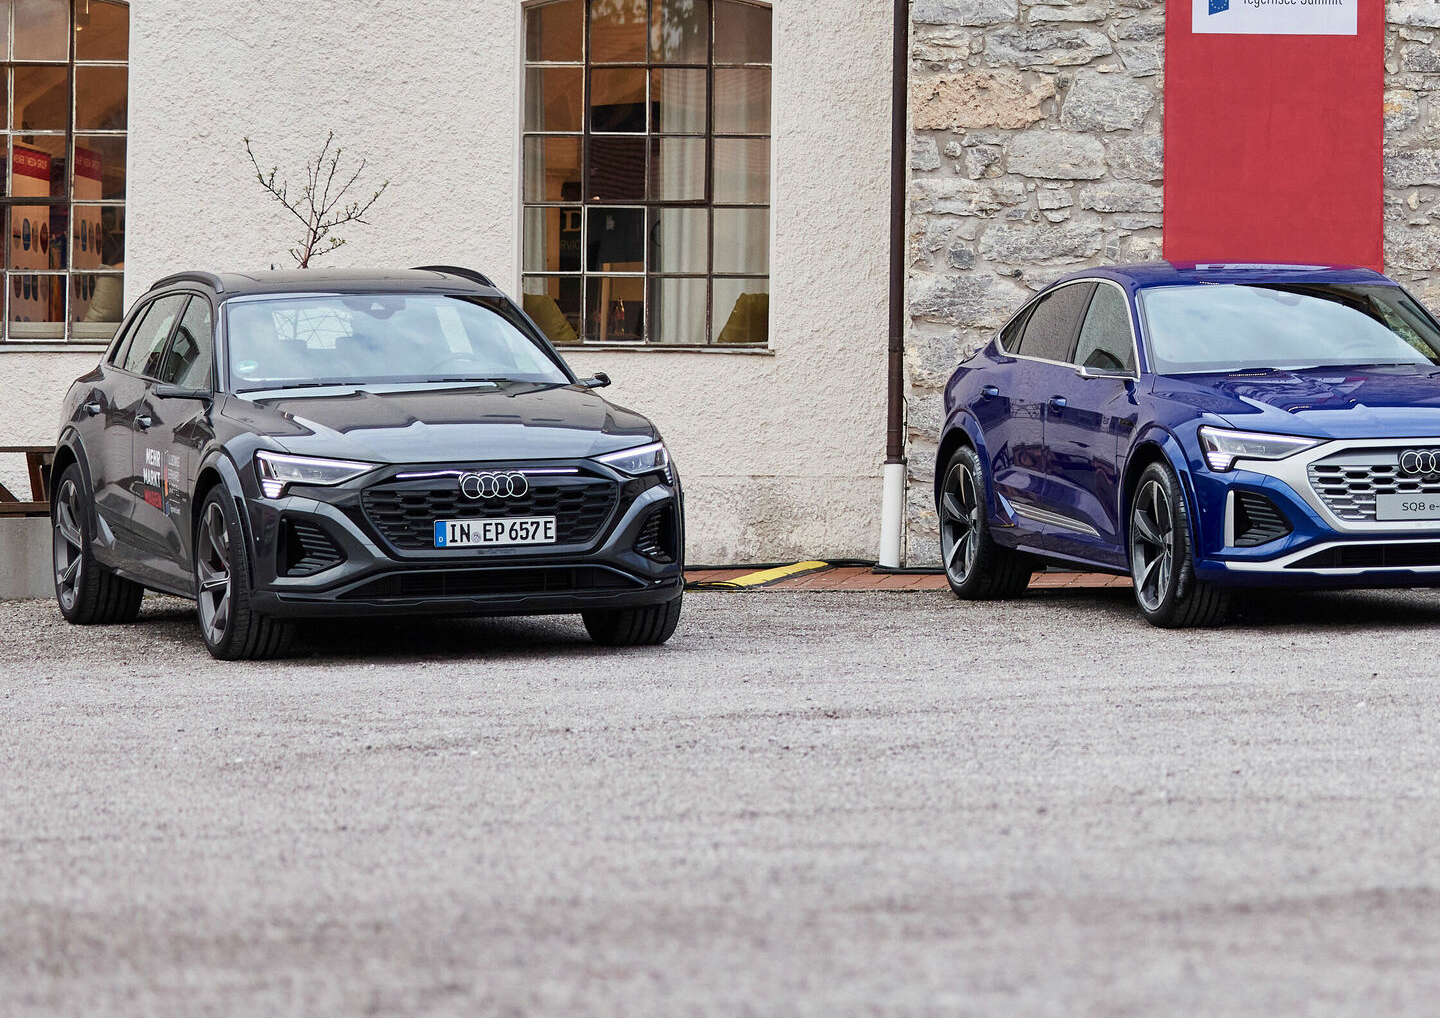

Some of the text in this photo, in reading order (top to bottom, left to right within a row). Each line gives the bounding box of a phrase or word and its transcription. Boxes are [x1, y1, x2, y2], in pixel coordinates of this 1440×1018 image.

[1401, 501, 1426, 512] SQ8
[449, 523, 471, 543] IN
[482, 522, 505, 542] EP
